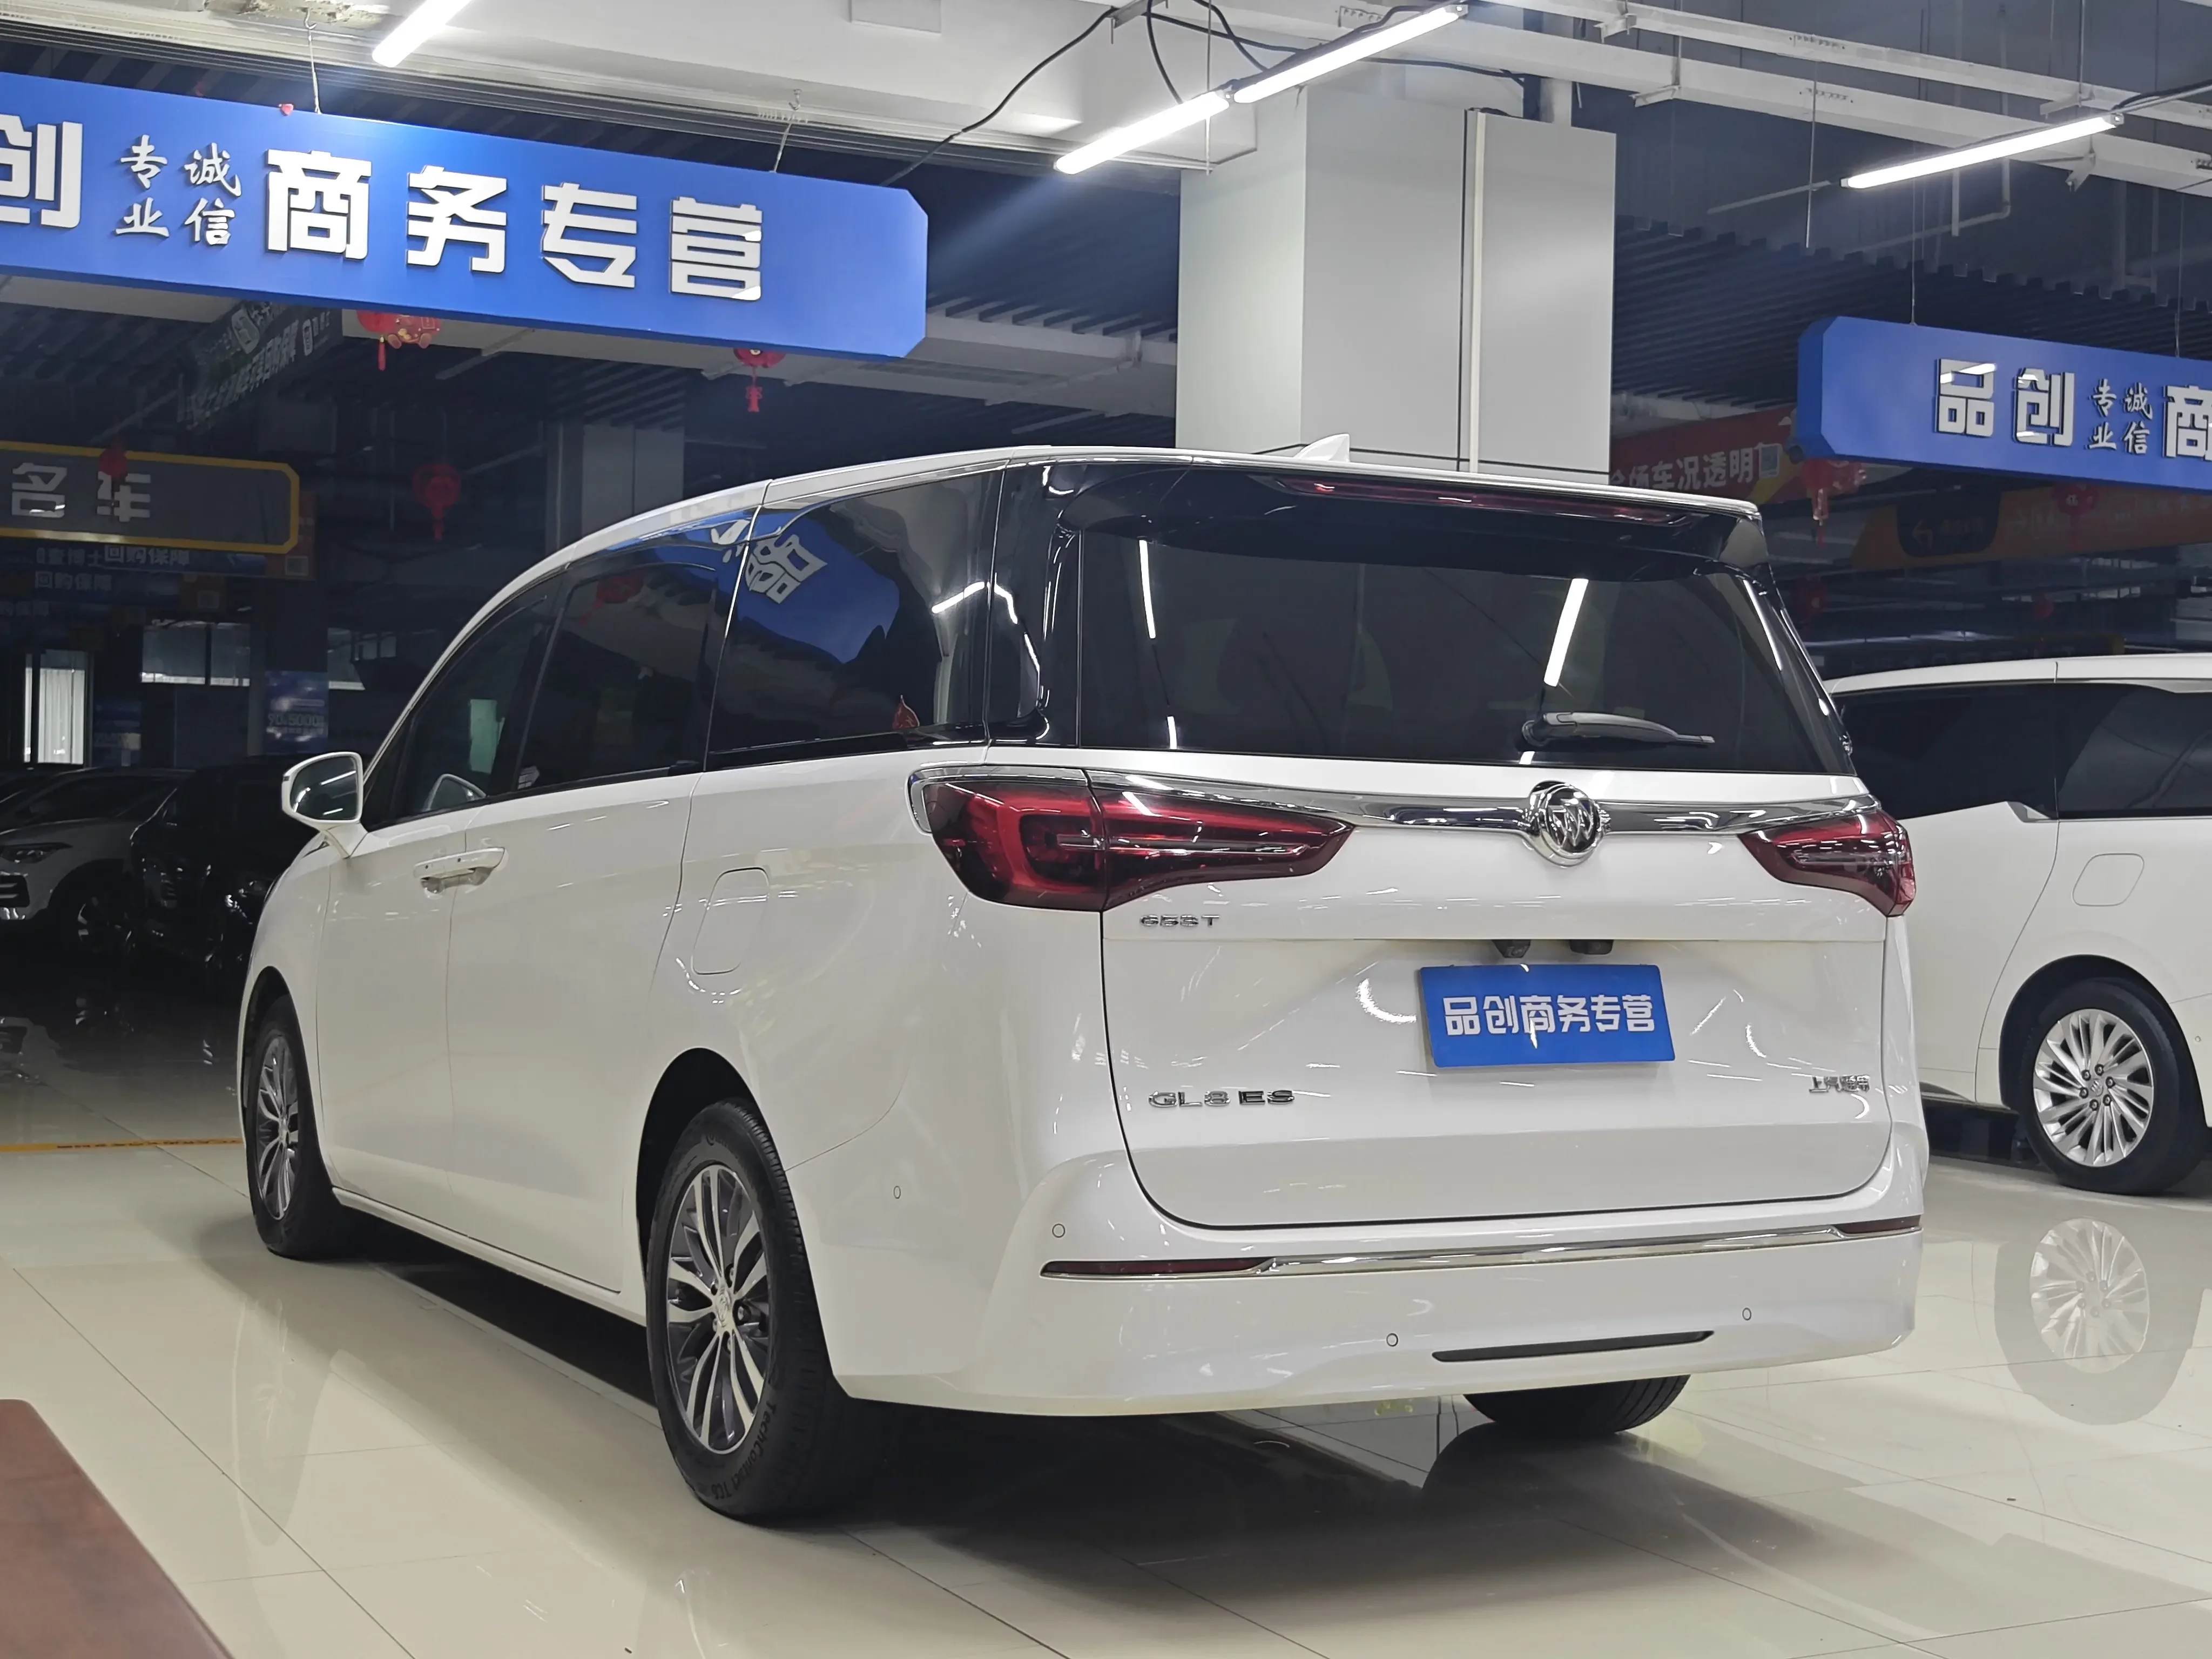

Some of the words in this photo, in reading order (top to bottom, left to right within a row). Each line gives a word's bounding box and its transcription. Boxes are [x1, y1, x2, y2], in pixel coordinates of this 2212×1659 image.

[267, 149, 763, 301] 商务专营
[1936, 358, 2075, 447] 品创
[1442, 994, 1655, 1036] 品创商务专营
[1148, 1090, 1231, 1108] GL8
[1238, 1090, 1295, 1105] ES
